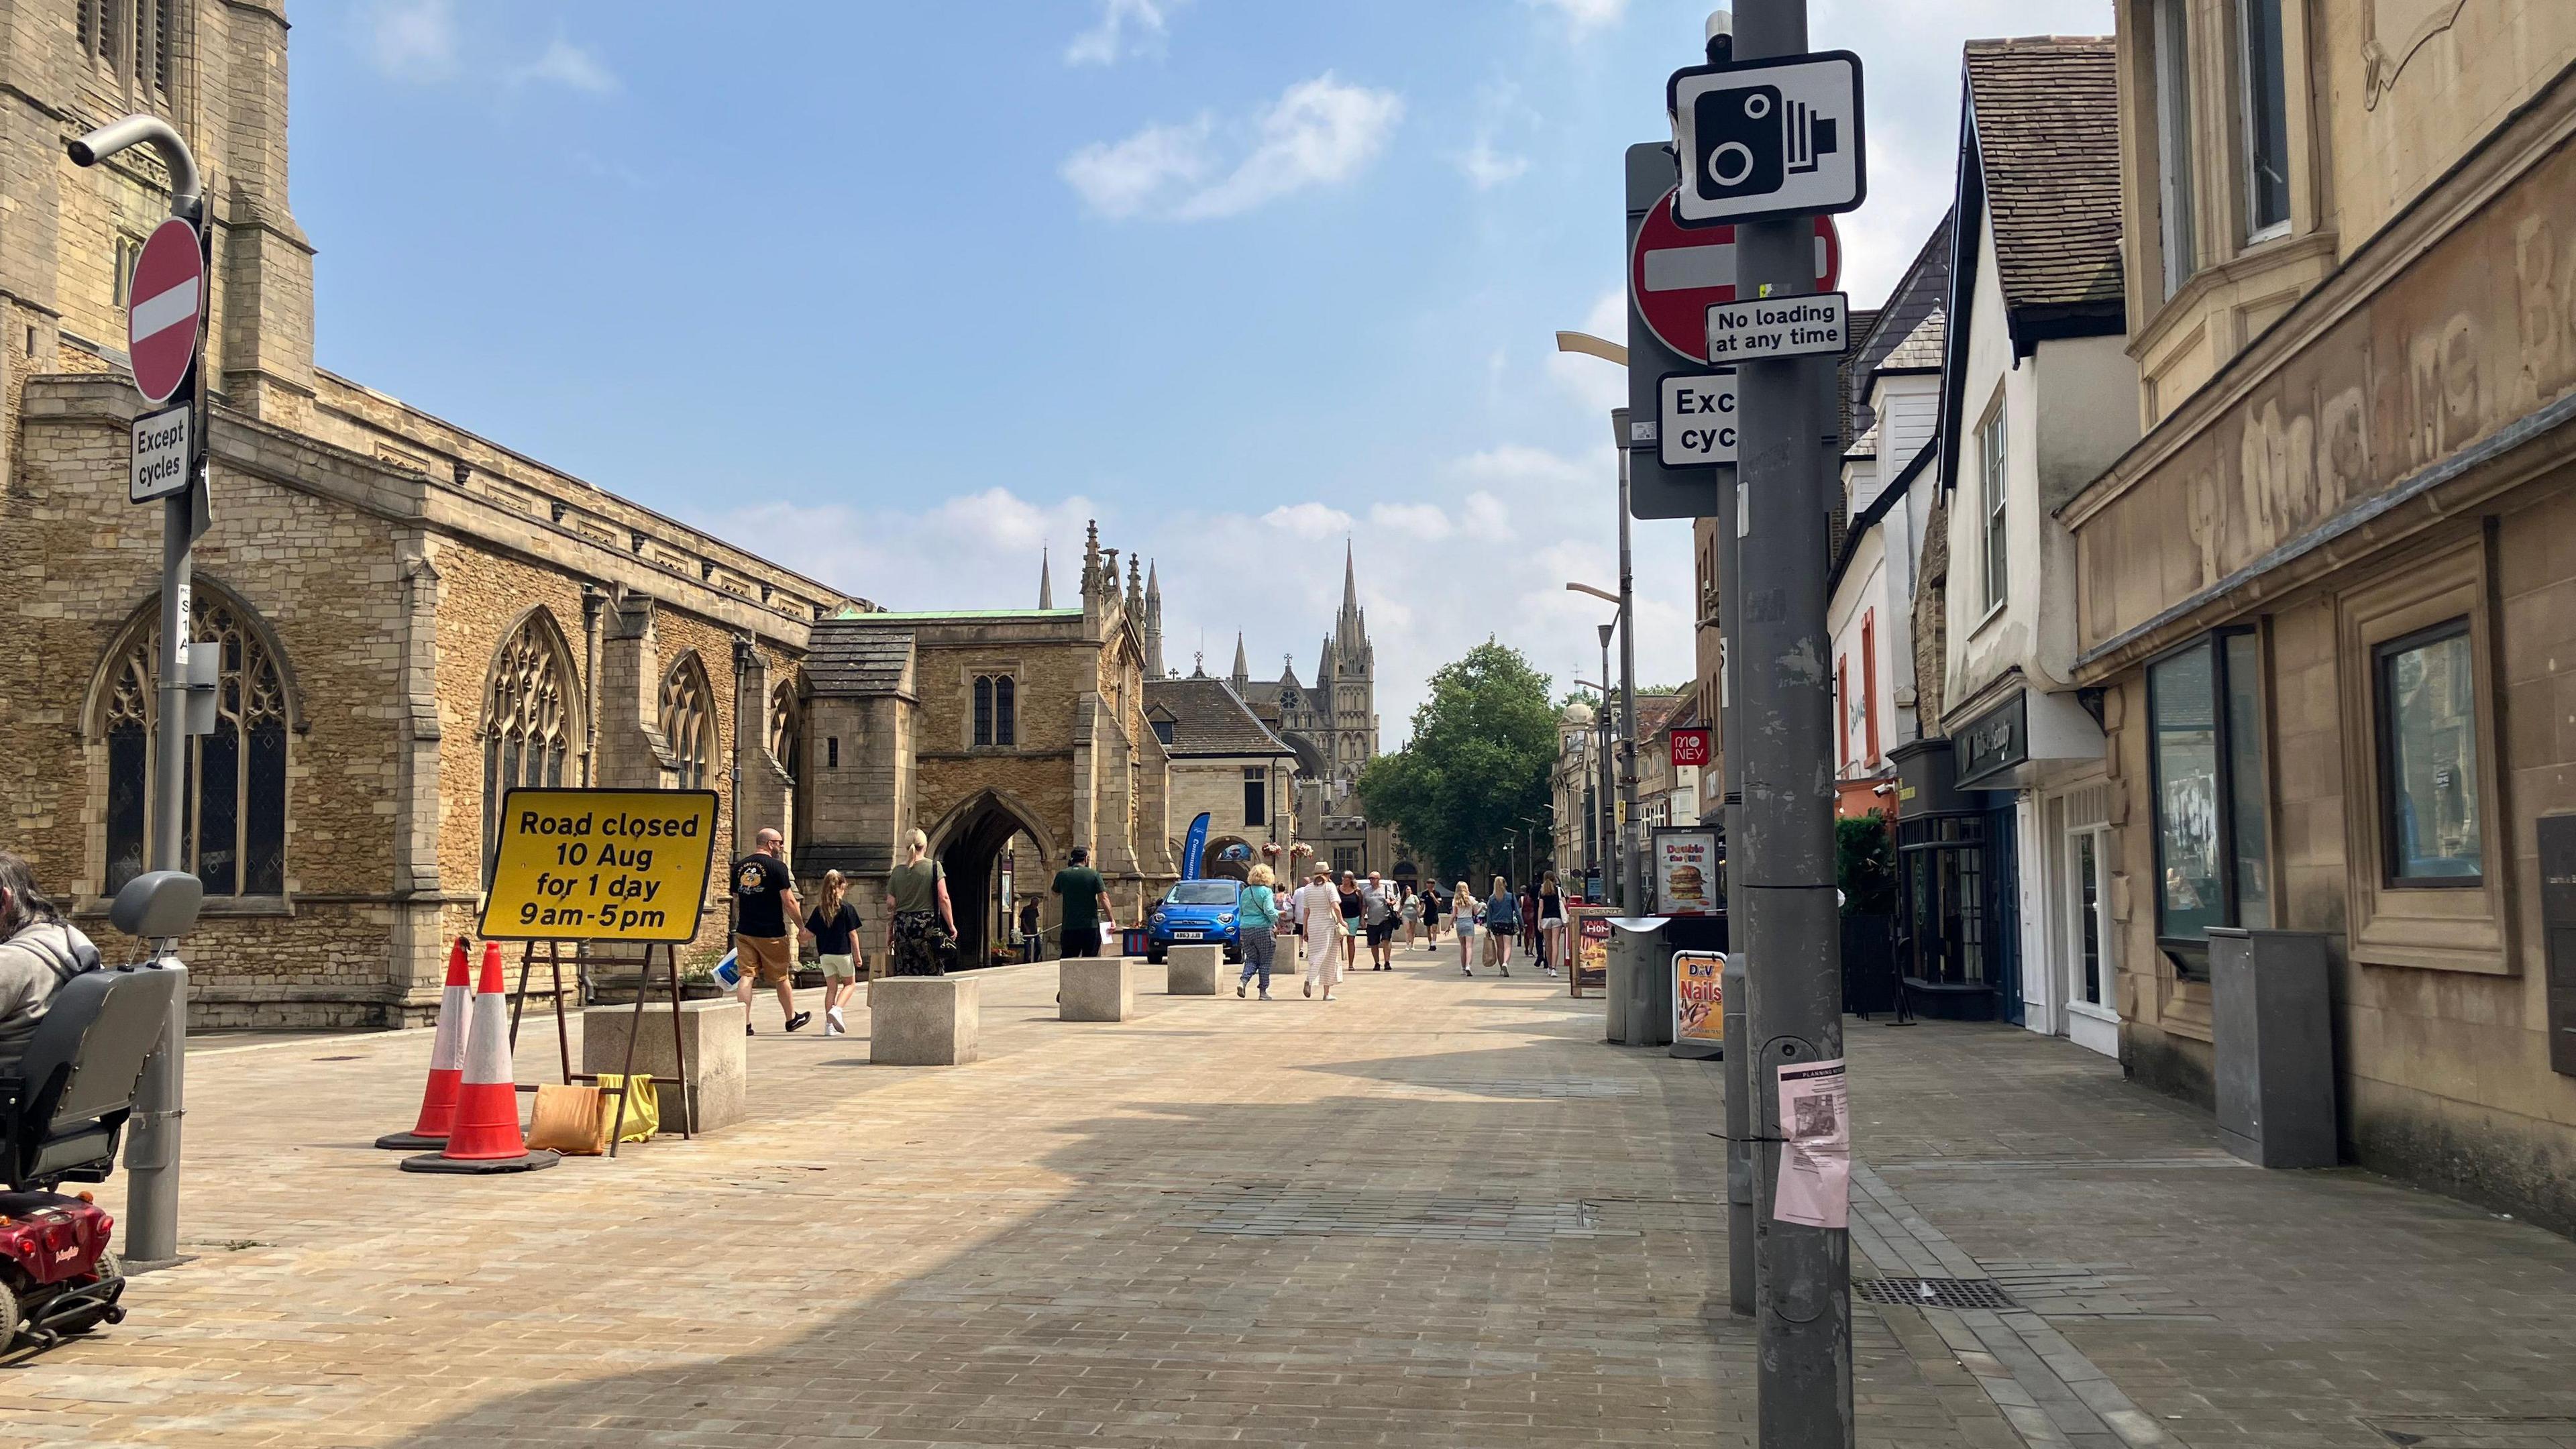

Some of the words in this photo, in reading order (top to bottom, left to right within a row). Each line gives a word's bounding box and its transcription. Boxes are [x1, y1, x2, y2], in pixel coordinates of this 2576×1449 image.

[1719, 311, 1748, 330] No
[1756, 305, 1835, 325] loading
[1716, 335, 1737, 352] at
[1745, 333, 1782, 350] any
[1790, 328, 1837, 345] time
[1677, 389, 1735, 414] Exc
[138, 419, 183, 453] Except
[1681, 428, 1736, 453] cyc
[139, 455, 180, 487] cycles
[182, 600, 189, 612] S
[182, 619, 187, 631] 1
[1675, 748, 1704, 760] NEY
[520, 811, 592, 835] Road
[602, 812, 698, 837] closed
[557, 843, 588, 865] 10
[596, 843, 653, 871] Aug
[1666, 844, 1705, 853] Double
[1684, 854, 1702, 863] fun
[537, 873, 578, 896] for
[588, 873, 598, 896] 1
[608, 875, 661, 902] day
[1680, 980, 1722, 1002] Nails
[1803, 1069, 1832, 1077] PLANNING
